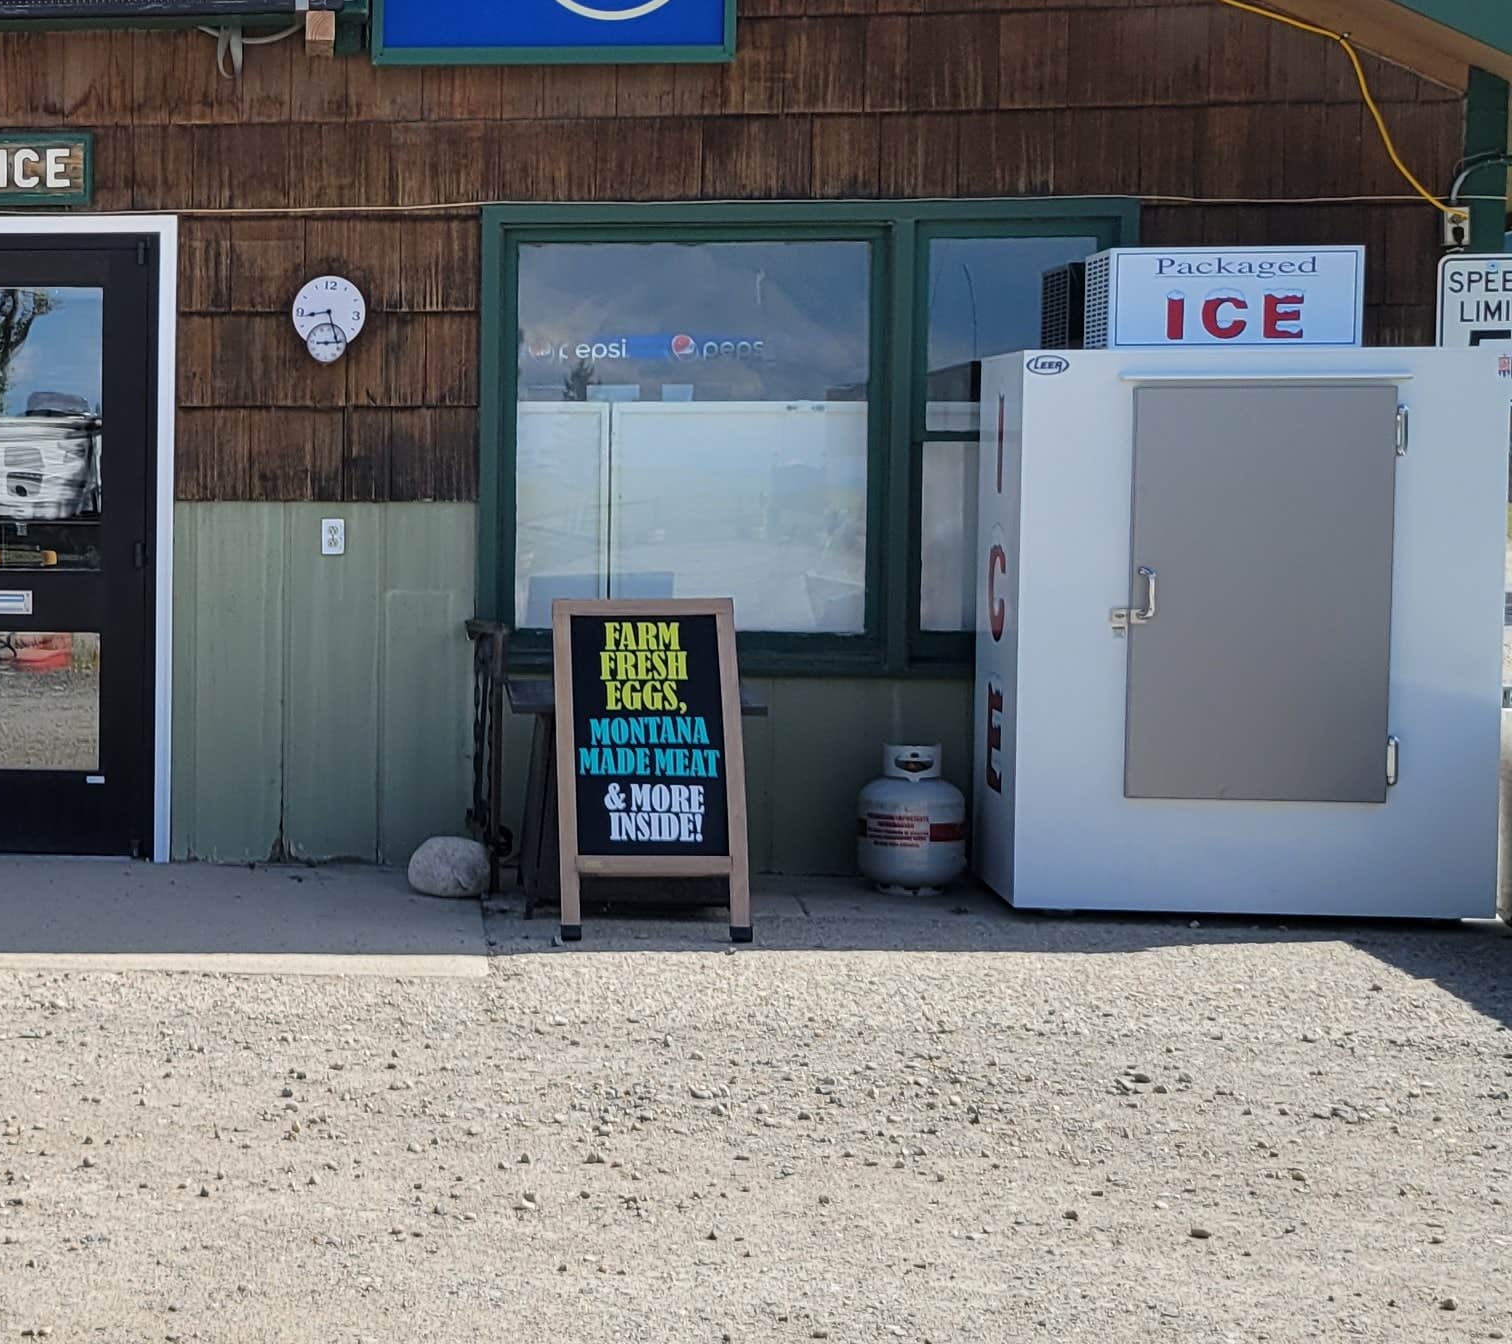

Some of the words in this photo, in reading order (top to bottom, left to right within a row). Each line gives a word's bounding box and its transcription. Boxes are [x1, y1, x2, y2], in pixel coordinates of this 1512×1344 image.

[1155, 256, 1318, 278] Packaged
[324, 280, 338, 291] 12
[352, 311, 360, 321] 3
[1166, 288, 1306, 340] ICE
[604, 622, 679, 650] FARM
[600, 651, 688, 680] FRESH
[605, 681, 687, 714] EGGS,
[589, 717, 710, 745] MONTANA
[579, 748, 650, 776] MADE
[654, 749, 719, 778] MEAT
[604, 782, 626, 810] &
[630, 784, 705, 814] MORE
[609, 812, 703, 843] INSIDE!
